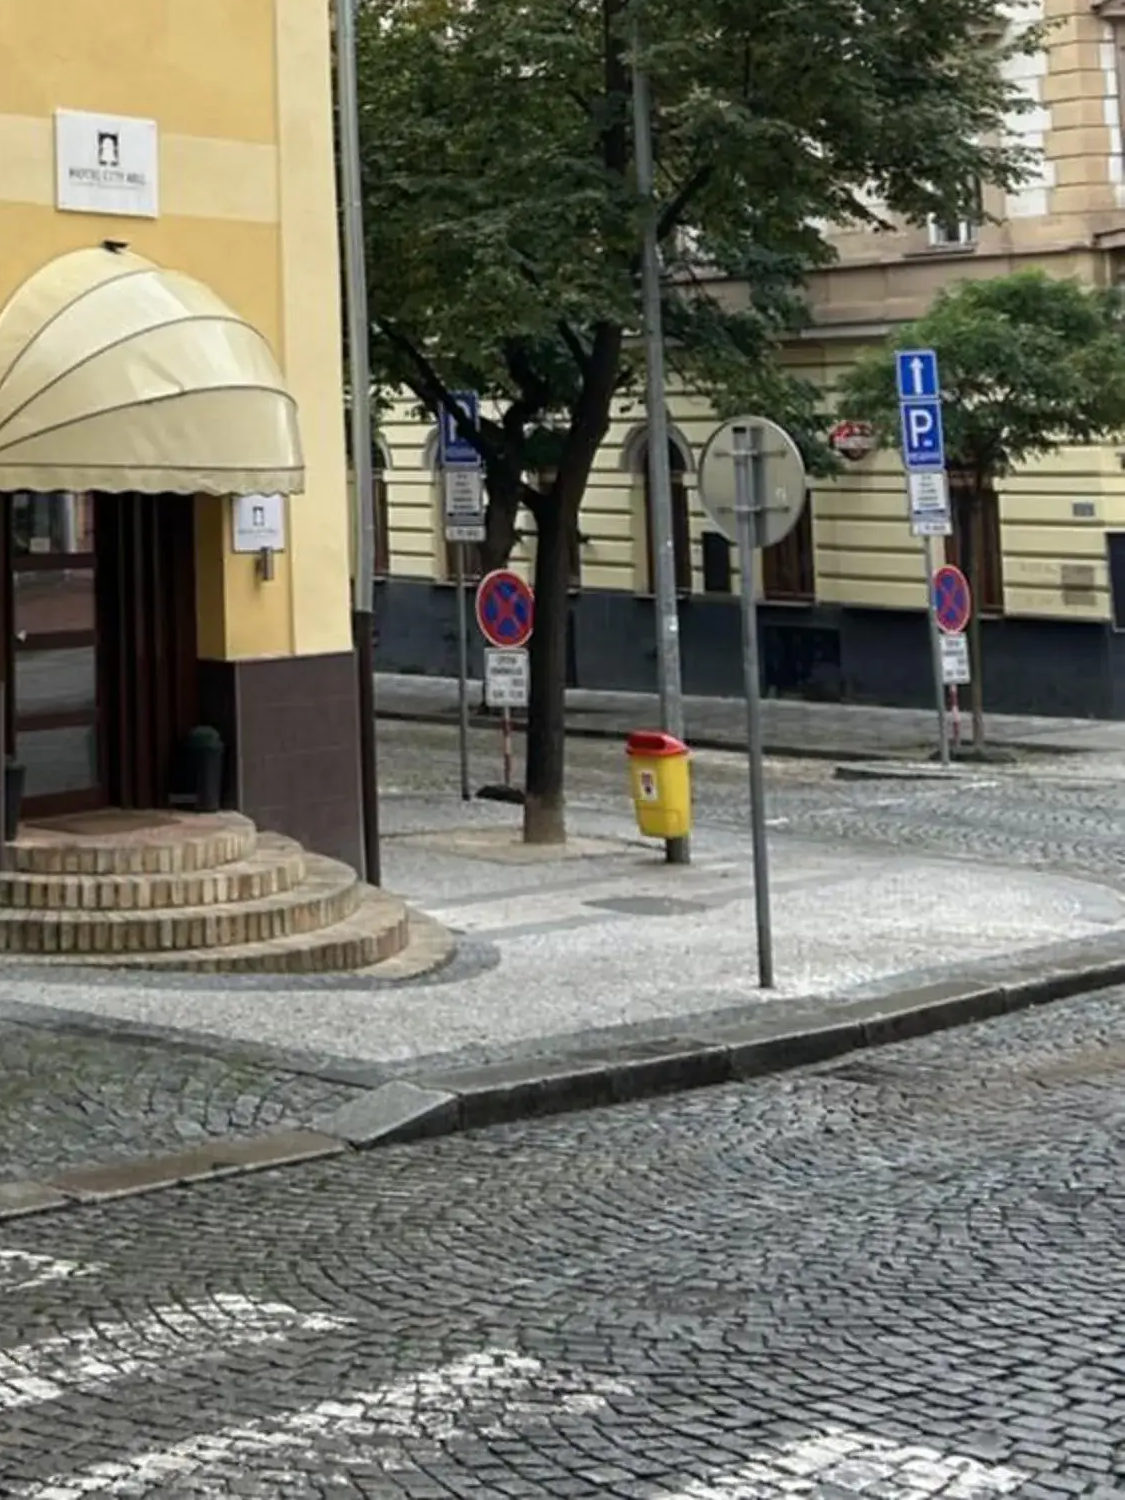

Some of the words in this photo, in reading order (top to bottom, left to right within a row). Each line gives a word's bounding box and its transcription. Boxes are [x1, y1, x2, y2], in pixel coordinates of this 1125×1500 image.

[69, 168, 100, 181] HOTEL
[103, 169, 124, 182] CITY
[909, 408, 933, 449] P
